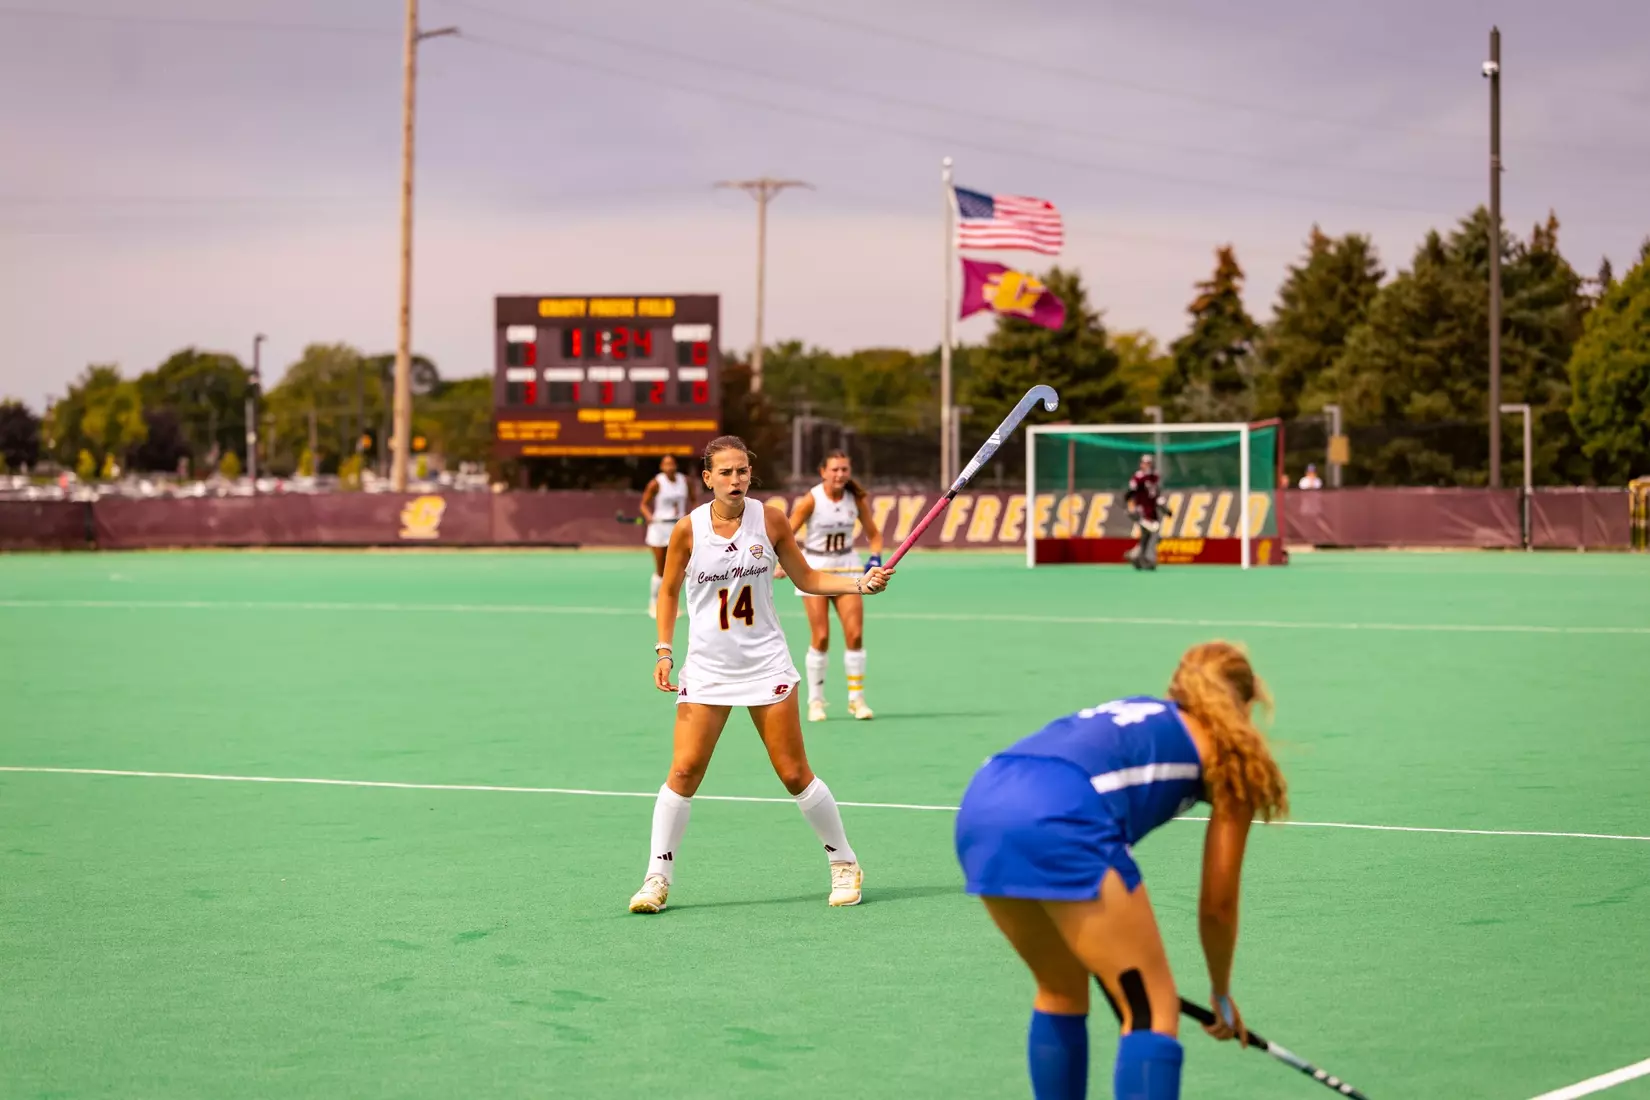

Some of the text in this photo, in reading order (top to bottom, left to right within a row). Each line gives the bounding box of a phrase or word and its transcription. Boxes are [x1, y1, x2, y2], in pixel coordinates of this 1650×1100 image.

[571, 326, 652, 359] 11:24
[940, 493, 1115, 542] FREESE
[1131, 492, 1271, 539] IELD
[826, 533, 846, 552] 10
[698, 565, 768, 584] Central Michigan
[718, 585, 755, 631] 14
